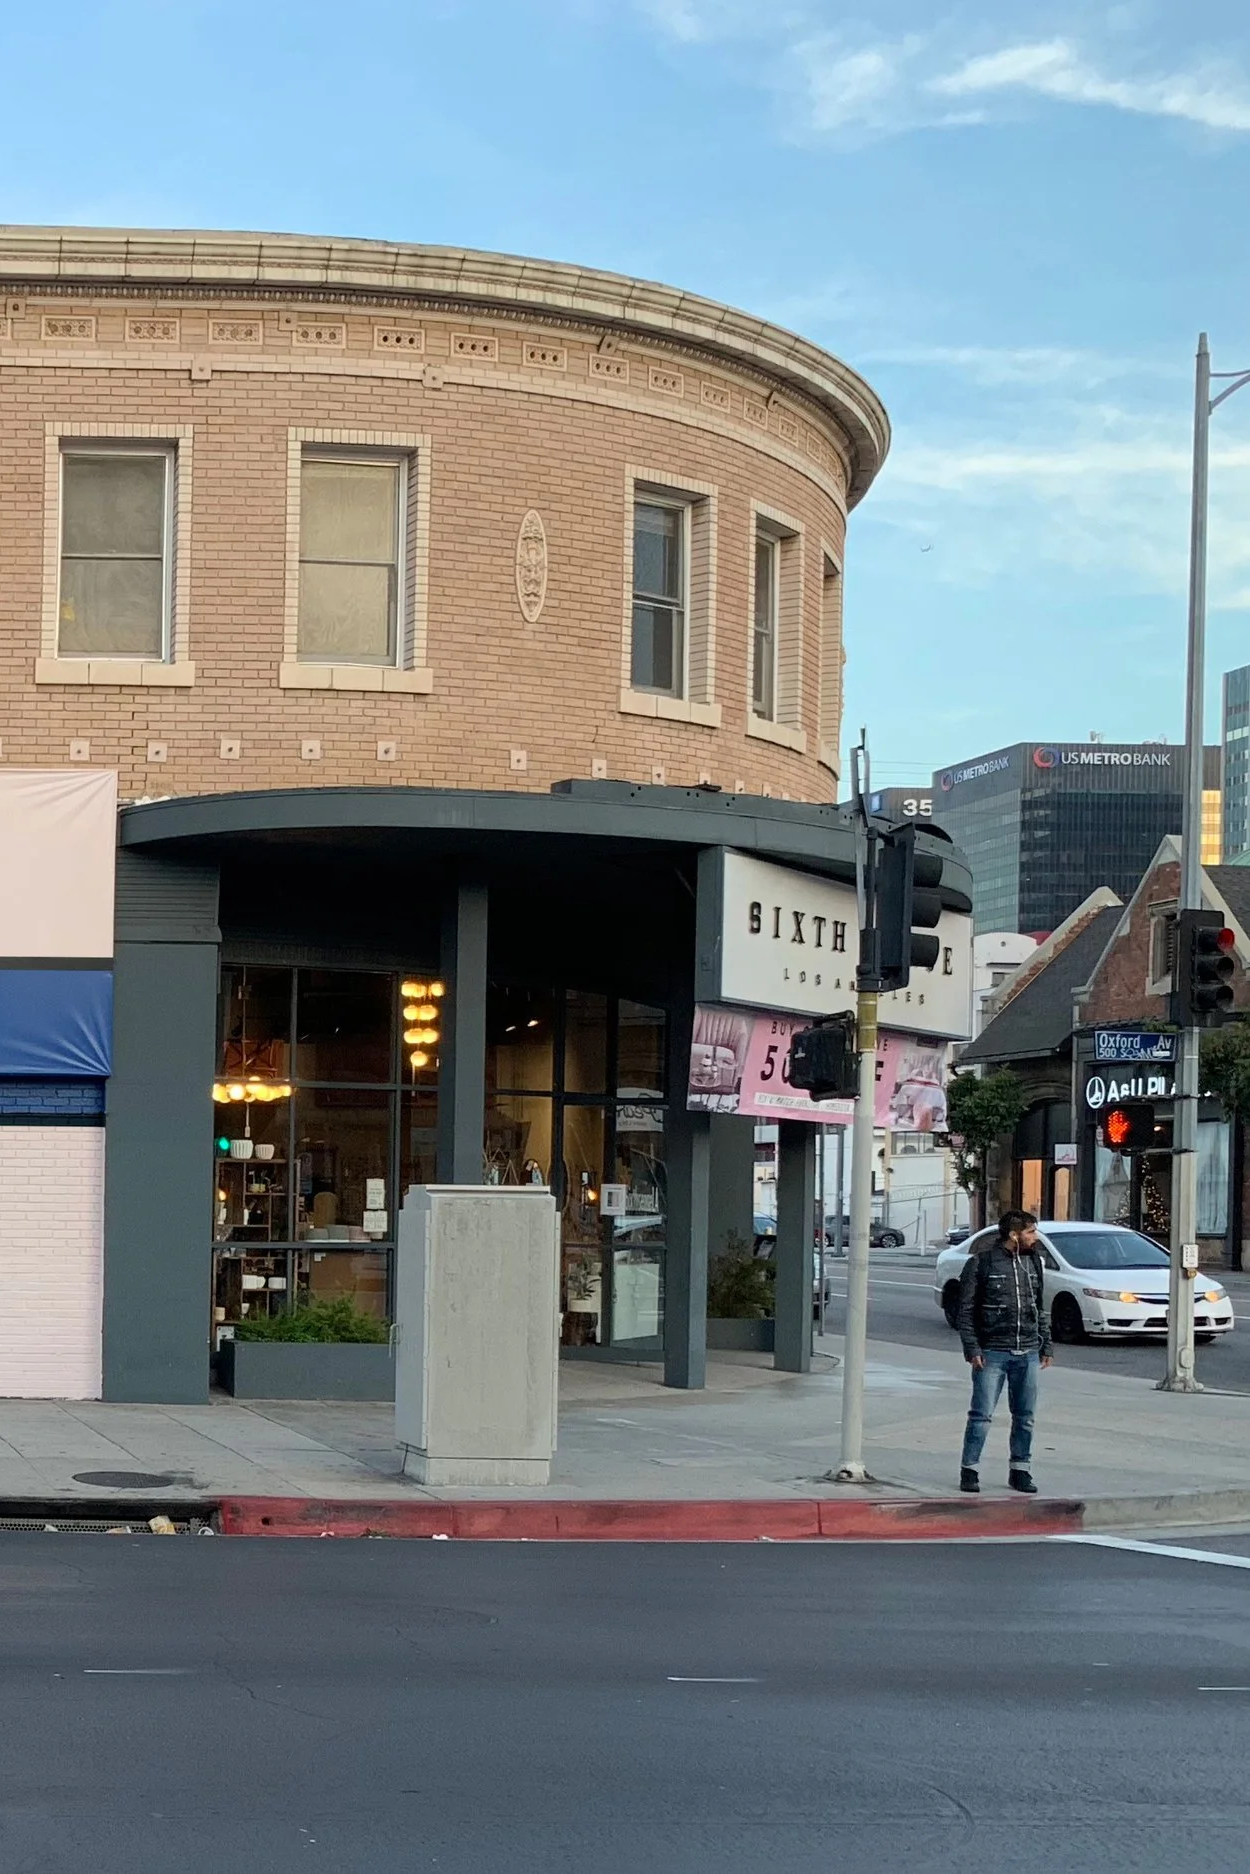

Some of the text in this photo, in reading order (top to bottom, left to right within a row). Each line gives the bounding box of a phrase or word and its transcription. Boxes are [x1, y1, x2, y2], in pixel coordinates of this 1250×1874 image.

[1080, 752, 1132, 765] METRO
[1133, 753, 1171, 766] BANK
[749, 901, 847, 952] SIXTH
[784, 968, 822, 986] LOS
[1099, 1033, 1172, 1049] Oxford Av
[1099, 1048, 1117, 1058] 500
